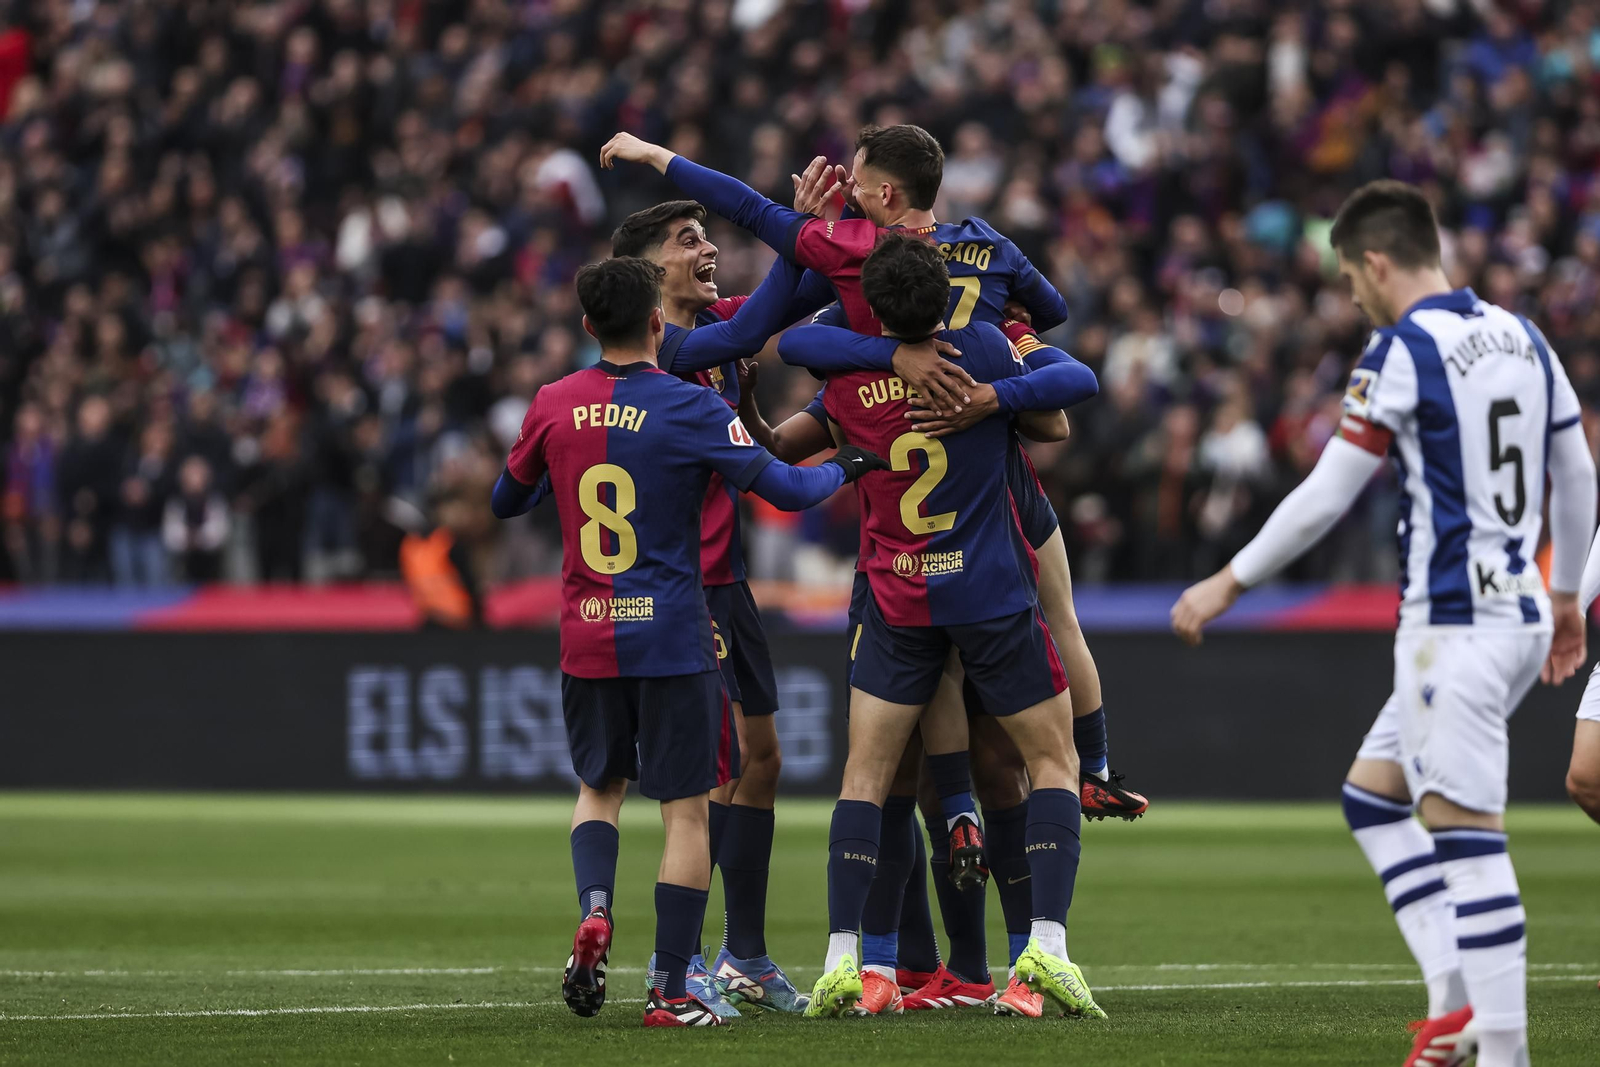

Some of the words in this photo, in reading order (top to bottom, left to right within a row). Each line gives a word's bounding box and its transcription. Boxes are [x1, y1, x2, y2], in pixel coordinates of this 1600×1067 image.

[939, 243, 995, 271] SADÓ
[948, 276, 981, 331] 7
[857, 376, 923, 409] CUBA
[572, 403, 648, 433] PEDRI
[1488, 397, 1526, 526] 5
[889, 431, 958, 535] 2
[578, 463, 638, 575] 8
[920, 550, 964, 563] UNHCR
[920, 559, 964, 573] ACNUR
[608, 596, 654, 608] UNHCR
[609, 606, 654, 618] ACNUR
[346, 664, 468, 780] ELS
